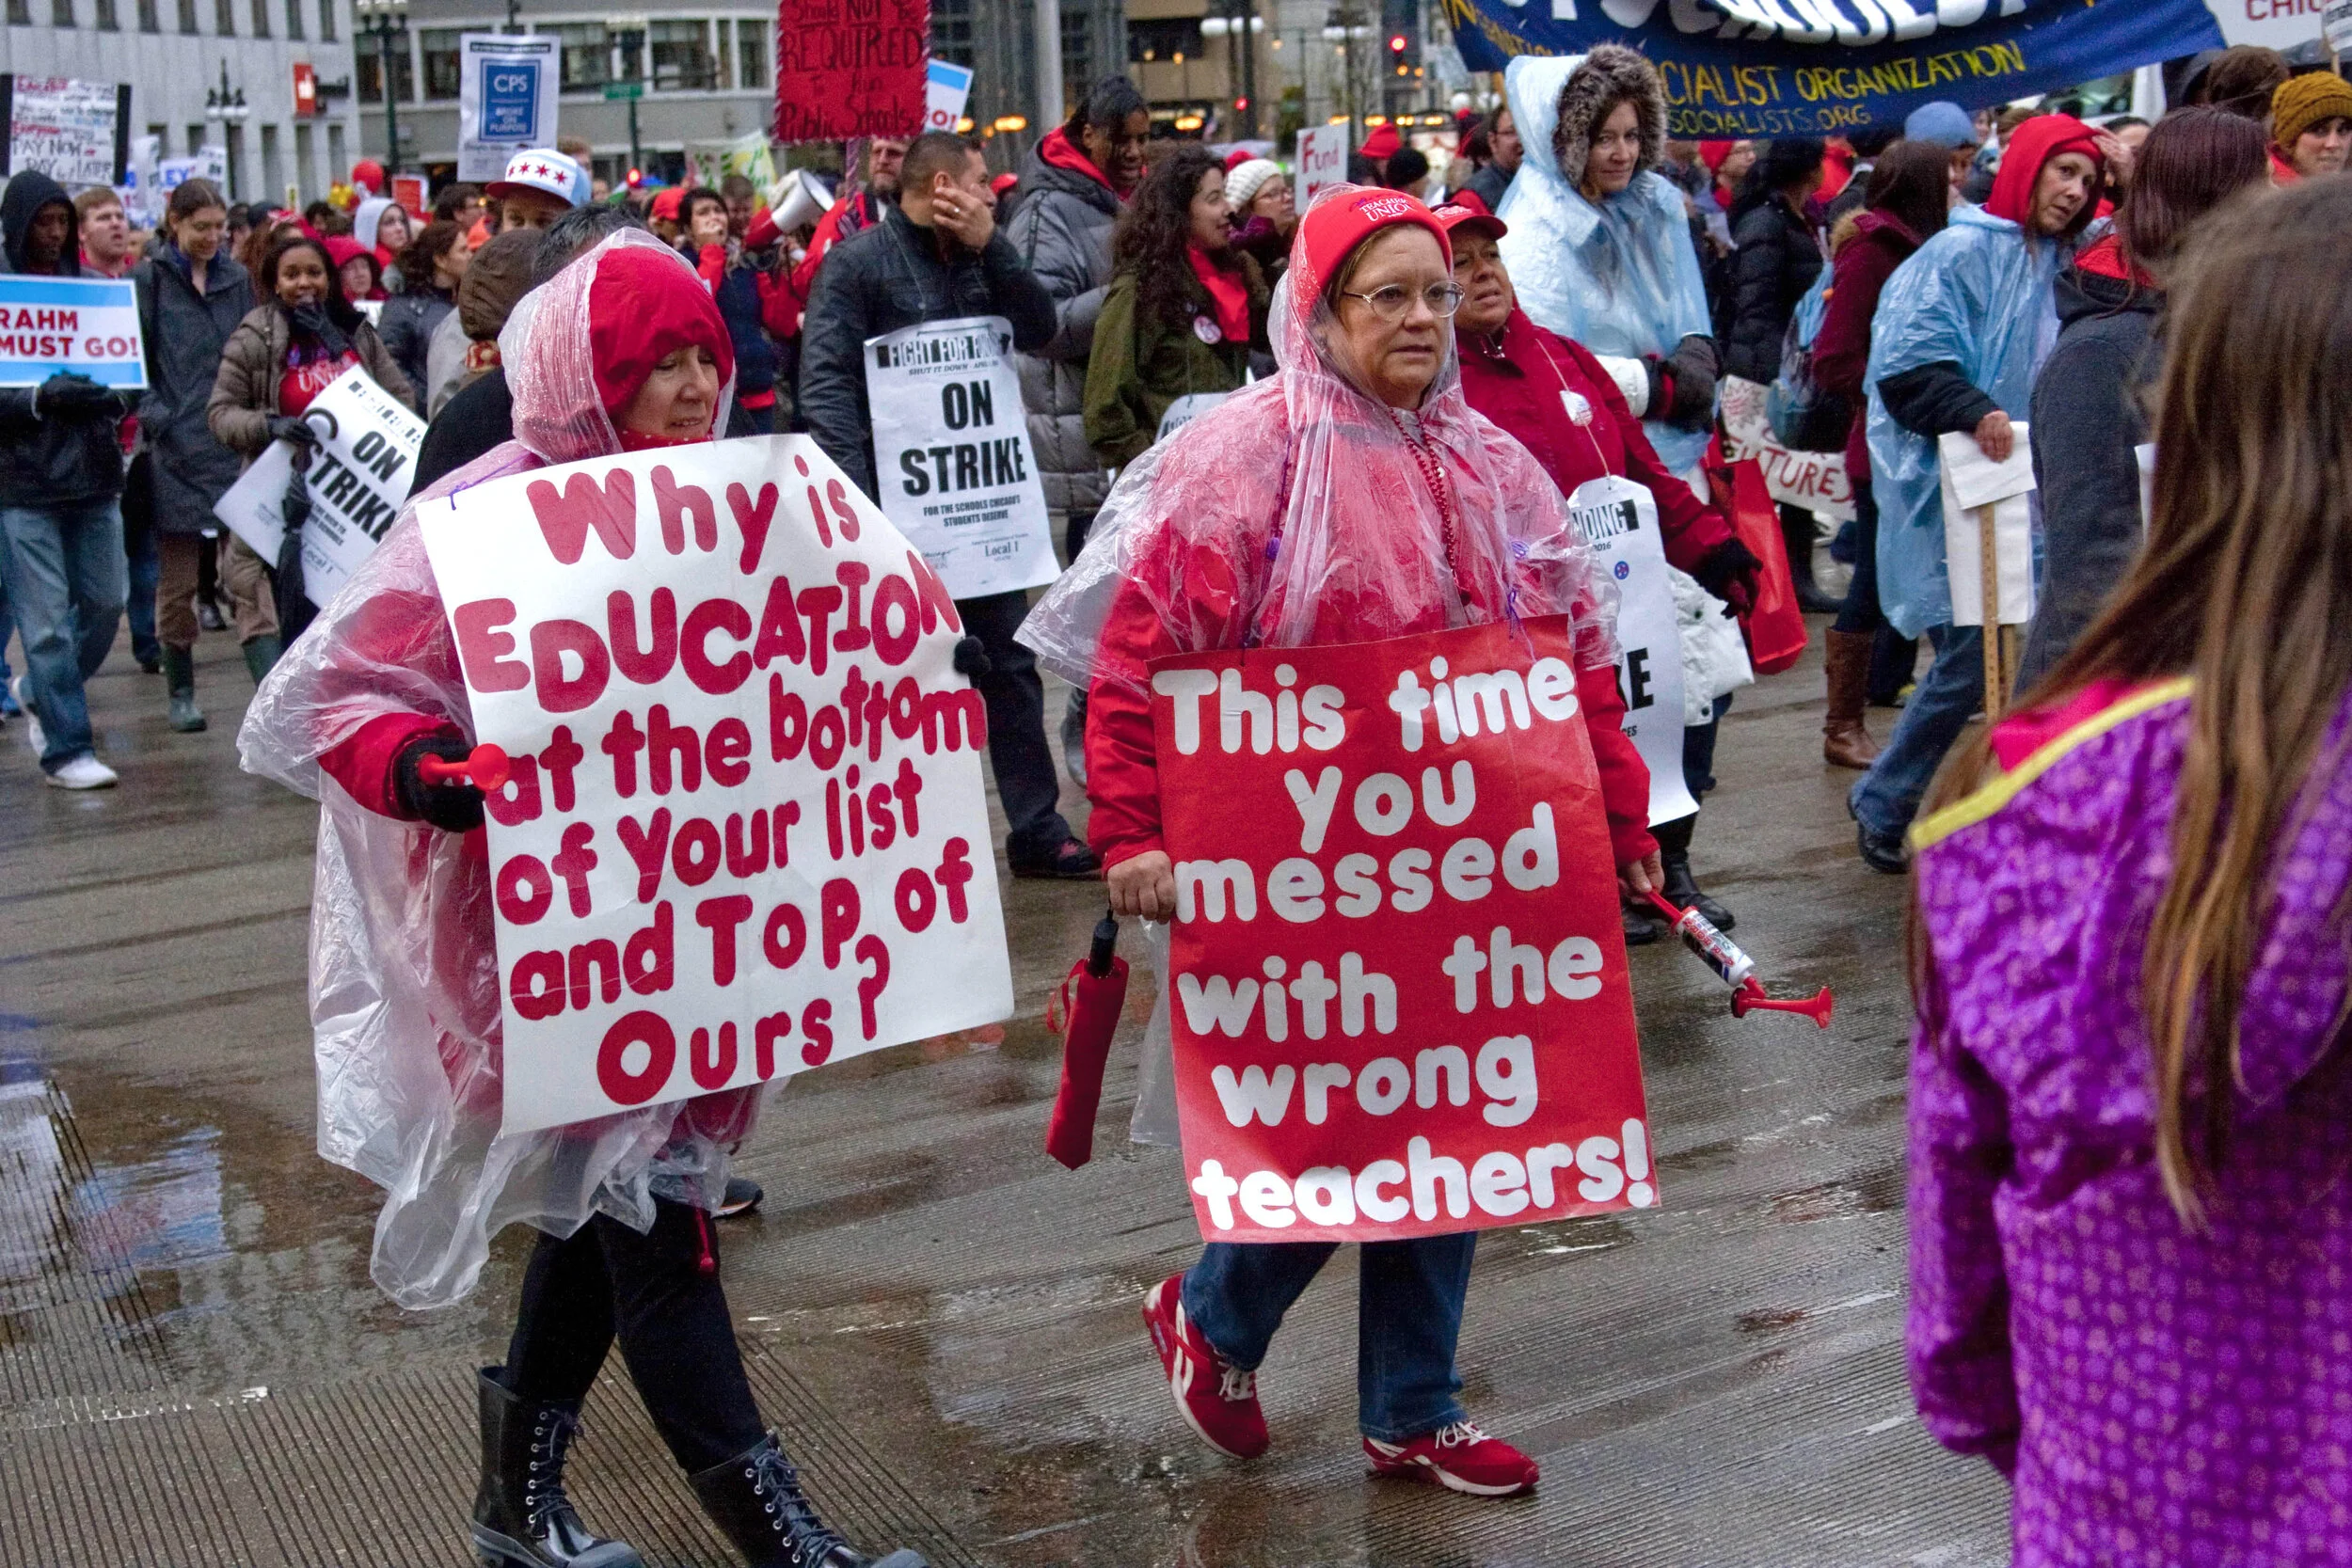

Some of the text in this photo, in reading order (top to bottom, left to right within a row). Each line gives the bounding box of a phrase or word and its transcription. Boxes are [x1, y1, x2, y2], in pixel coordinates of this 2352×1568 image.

[778, 26, 924, 72] REQUIRED
[1660, 60, 1783, 106] CIALIST
[1794, 40, 2027, 103] ORGANIZATION
[493, 73, 528, 93] CPS
[845, 93, 914, 137] Schools
[0, 308, 79, 332] RAHM
[0, 335, 139, 358] MUST GO!
[890, 340, 931, 369] FIGHT
[941, 334, 968, 362] FOR
[909, 365, 932, 376] SHUT
[933, 365, 943, 374] IT
[944, 362, 969, 373] DOWN
[941, 380, 994, 432] ON
[351, 430, 408, 483] ON
[899, 436, 1027, 497] STRIKE
[1728, 433, 1840, 498] TURE
[525, 454, 861, 576] Why is
[923, 503, 939, 516] FOR
[941, 502, 954, 515] THE
[954, 498, 988, 512] SCHOOLS
[943, 509, 1009, 528] STUDENTS DESERVE
[1572, 500, 1629, 543] NDING
[984, 541, 1010, 558] Local
[453, 549, 961, 714] EDUCATION
[1152, 662, 1346, 756] This
[1388, 655, 1579, 752] time
[485, 664, 989, 828] at the bottom
[1283, 759, 1476, 854] you
[496, 820, 598, 926] of
[825, 757, 923, 862] list
[1173, 800, 1561, 925] messed
[509, 899, 675, 1022] and
[894, 836, 974, 934] of
[1176, 950, 1398, 1043] with
[1441, 925, 1604, 1015] the
[1210, 1033, 1540, 1128] wrong
[1191, 1117, 1655, 1232] teachers!
